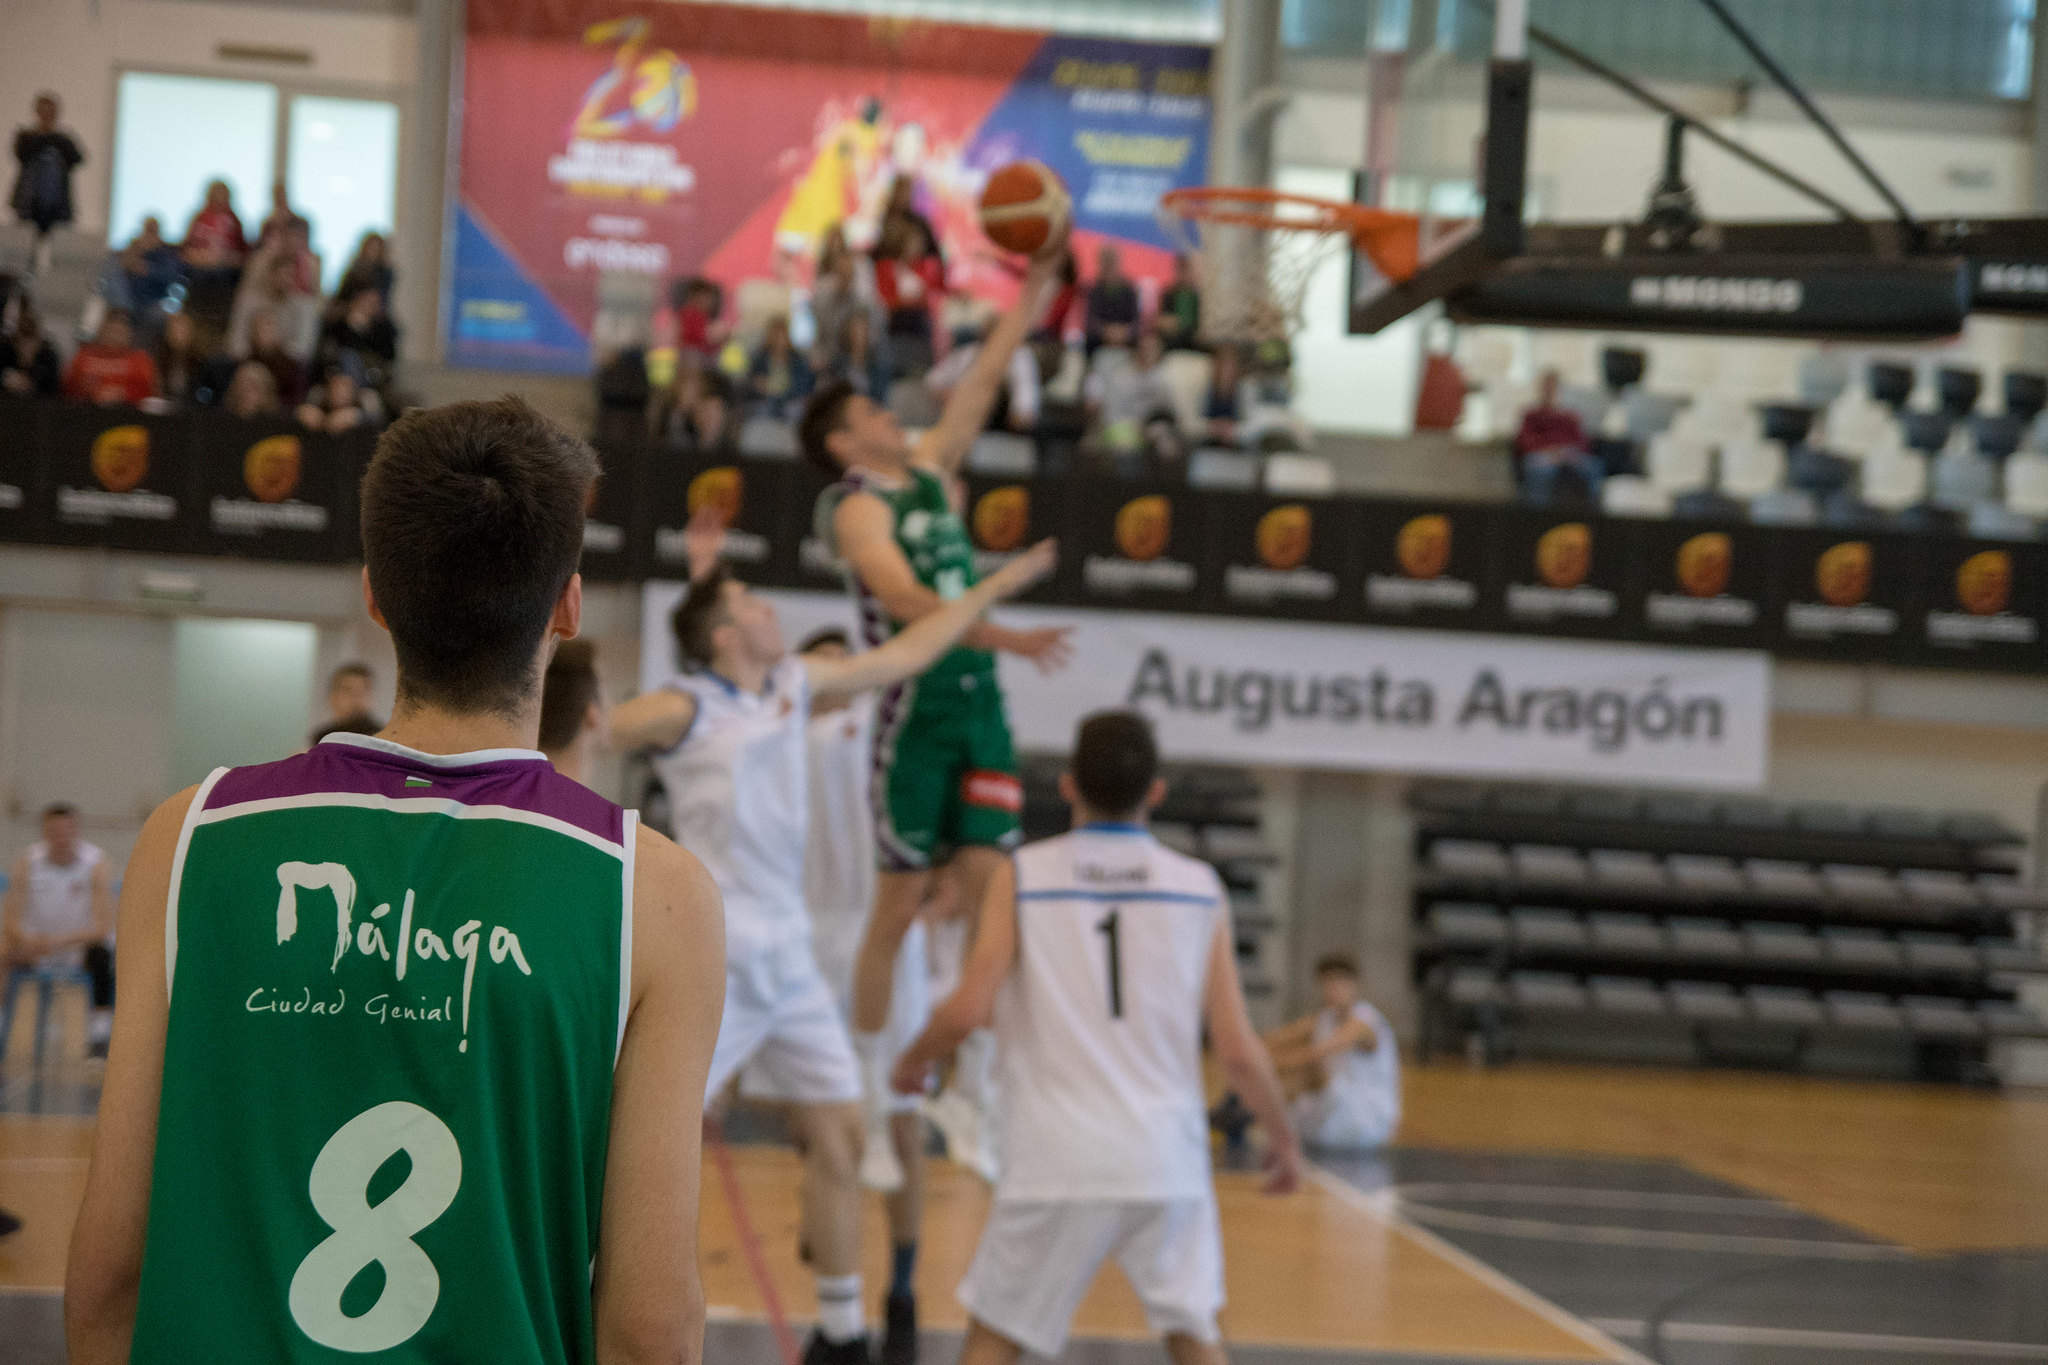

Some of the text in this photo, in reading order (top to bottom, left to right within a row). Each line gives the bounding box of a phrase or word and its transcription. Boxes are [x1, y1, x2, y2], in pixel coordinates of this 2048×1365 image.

[1128, 648, 1724, 752] Augusta Aragón
[245, 987, 451, 1024] Ciudad Genial
[277, 861, 532, 1053] Málaga
[1095, 909, 1124, 1019] 1
[288, 1101, 462, 1353] 8
